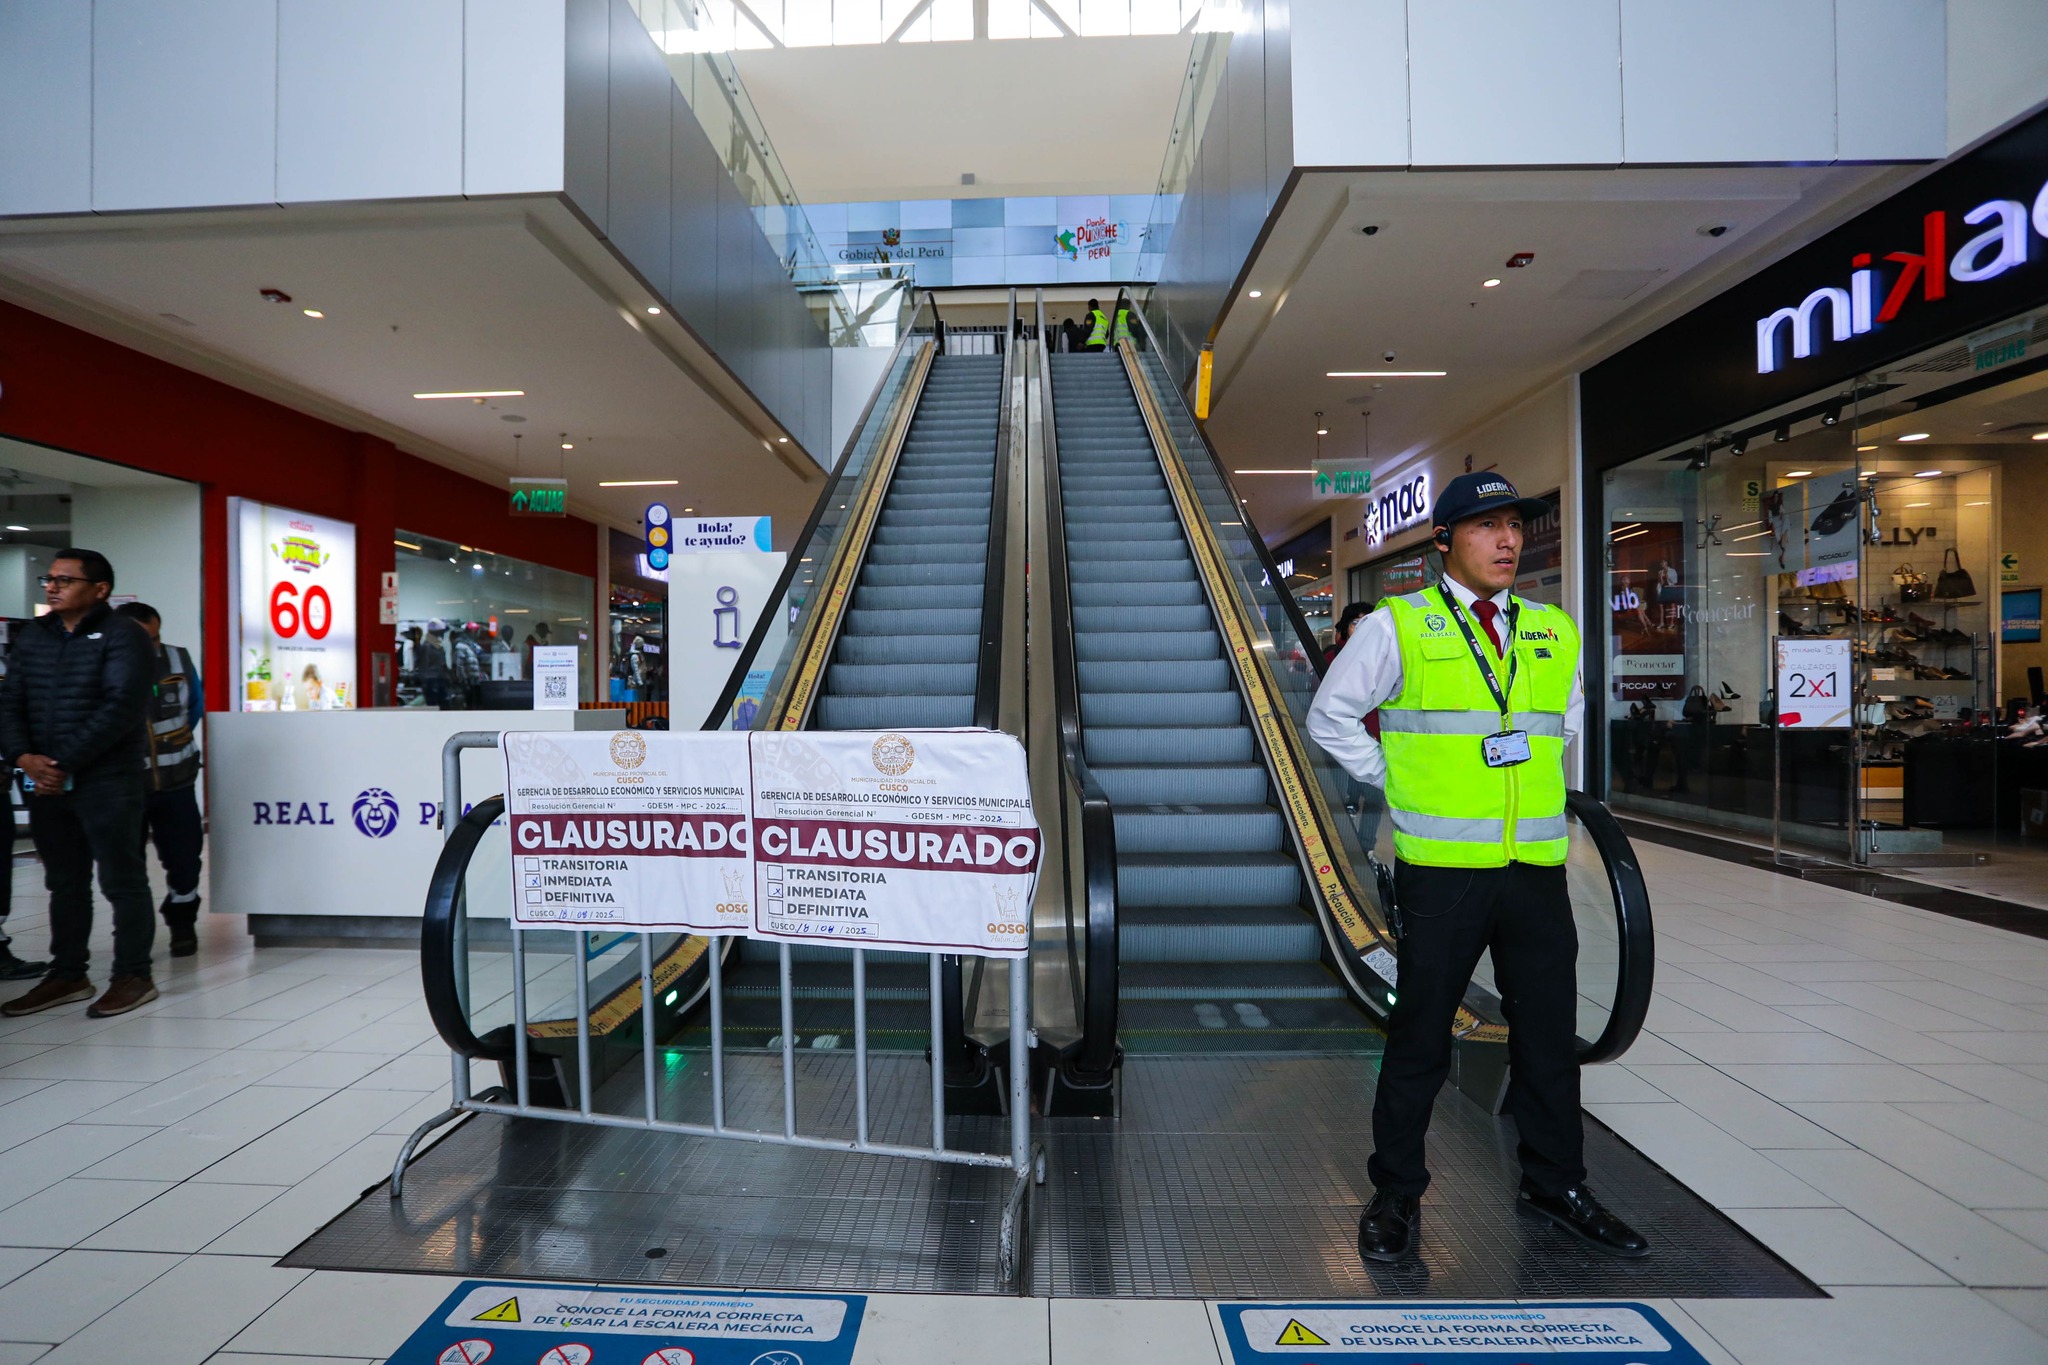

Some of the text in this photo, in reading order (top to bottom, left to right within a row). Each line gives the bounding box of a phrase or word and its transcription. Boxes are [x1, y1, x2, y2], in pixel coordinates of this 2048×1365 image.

[839, 246, 944, 260] Gobiero del Perú
[1757, 180, 2048, 374] mika
[1380, 476, 1425, 531] mac
[698, 522, 732, 533] Hola!
[685, 534, 746, 548] te ayudo?
[270, 581, 332, 640] 60
[1240, 657, 1257, 689] Precaución
[1620, 682, 1672, 690] PICCADLY
[1789, 671, 1836, 698] 2x1
[792, 678, 810, 711] Precaución
[1271, 736, 1282, 758] alejado
[1281, 766, 1292, 784] borde
[517, 785, 744, 796] GERENCIA DE DESARROLLO ECONÓMICO Y SERVICIOS MUNICIPAL
[879, 783, 908, 792] CUSCO
[760, 790, 800, 800] GERENCIA
[803, 792, 813, 800] DE
[815, 792, 869, 803] DESARROLLO
[872, 793, 921, 804] ECONÓMICO
[924, 796, 929, 804] Y
[931, 796, 977, 806] SERVICIOS
[572, 802, 605, 810] Gerencial
[647, 802, 674, 810] GDESM
[253, 802, 334, 825] REAL
[778, 807, 823, 815] Resolución
[826, 808, 864, 817] Gerencial
[911, 812, 943, 820] GDESM
[952, 813, 971, 821] MPC
[761, 825, 1036, 867] CLAUSURADO
[542, 860, 628, 871] TRANSITORIA
[543, 876, 612, 887] INMEDIATA
[786, 869, 887, 884] TRANSITORIA
[545, 891, 615, 903] DEFINITIVA
[787, 886, 867, 900] INMEDIATA
[787, 903, 869, 918] DEFINITIVA
[1326, 883, 1355, 929] Precaución
[987, 922, 1028, 934] QOSQ
[634, 1298, 699, 1306] SEGURIDAD
[556, 1305, 804, 1322] CONOCE LA FORMA CORRECTA
[533, 1316, 814, 1334] DE USAR LA ESCALERA MECÁNICA
[1350, 1324, 1616, 1334] CONOCE LA FORMA CORRECTA
[1340, 1334, 1643, 1346] DE USAR LA ESCALERA MECÁNICA
